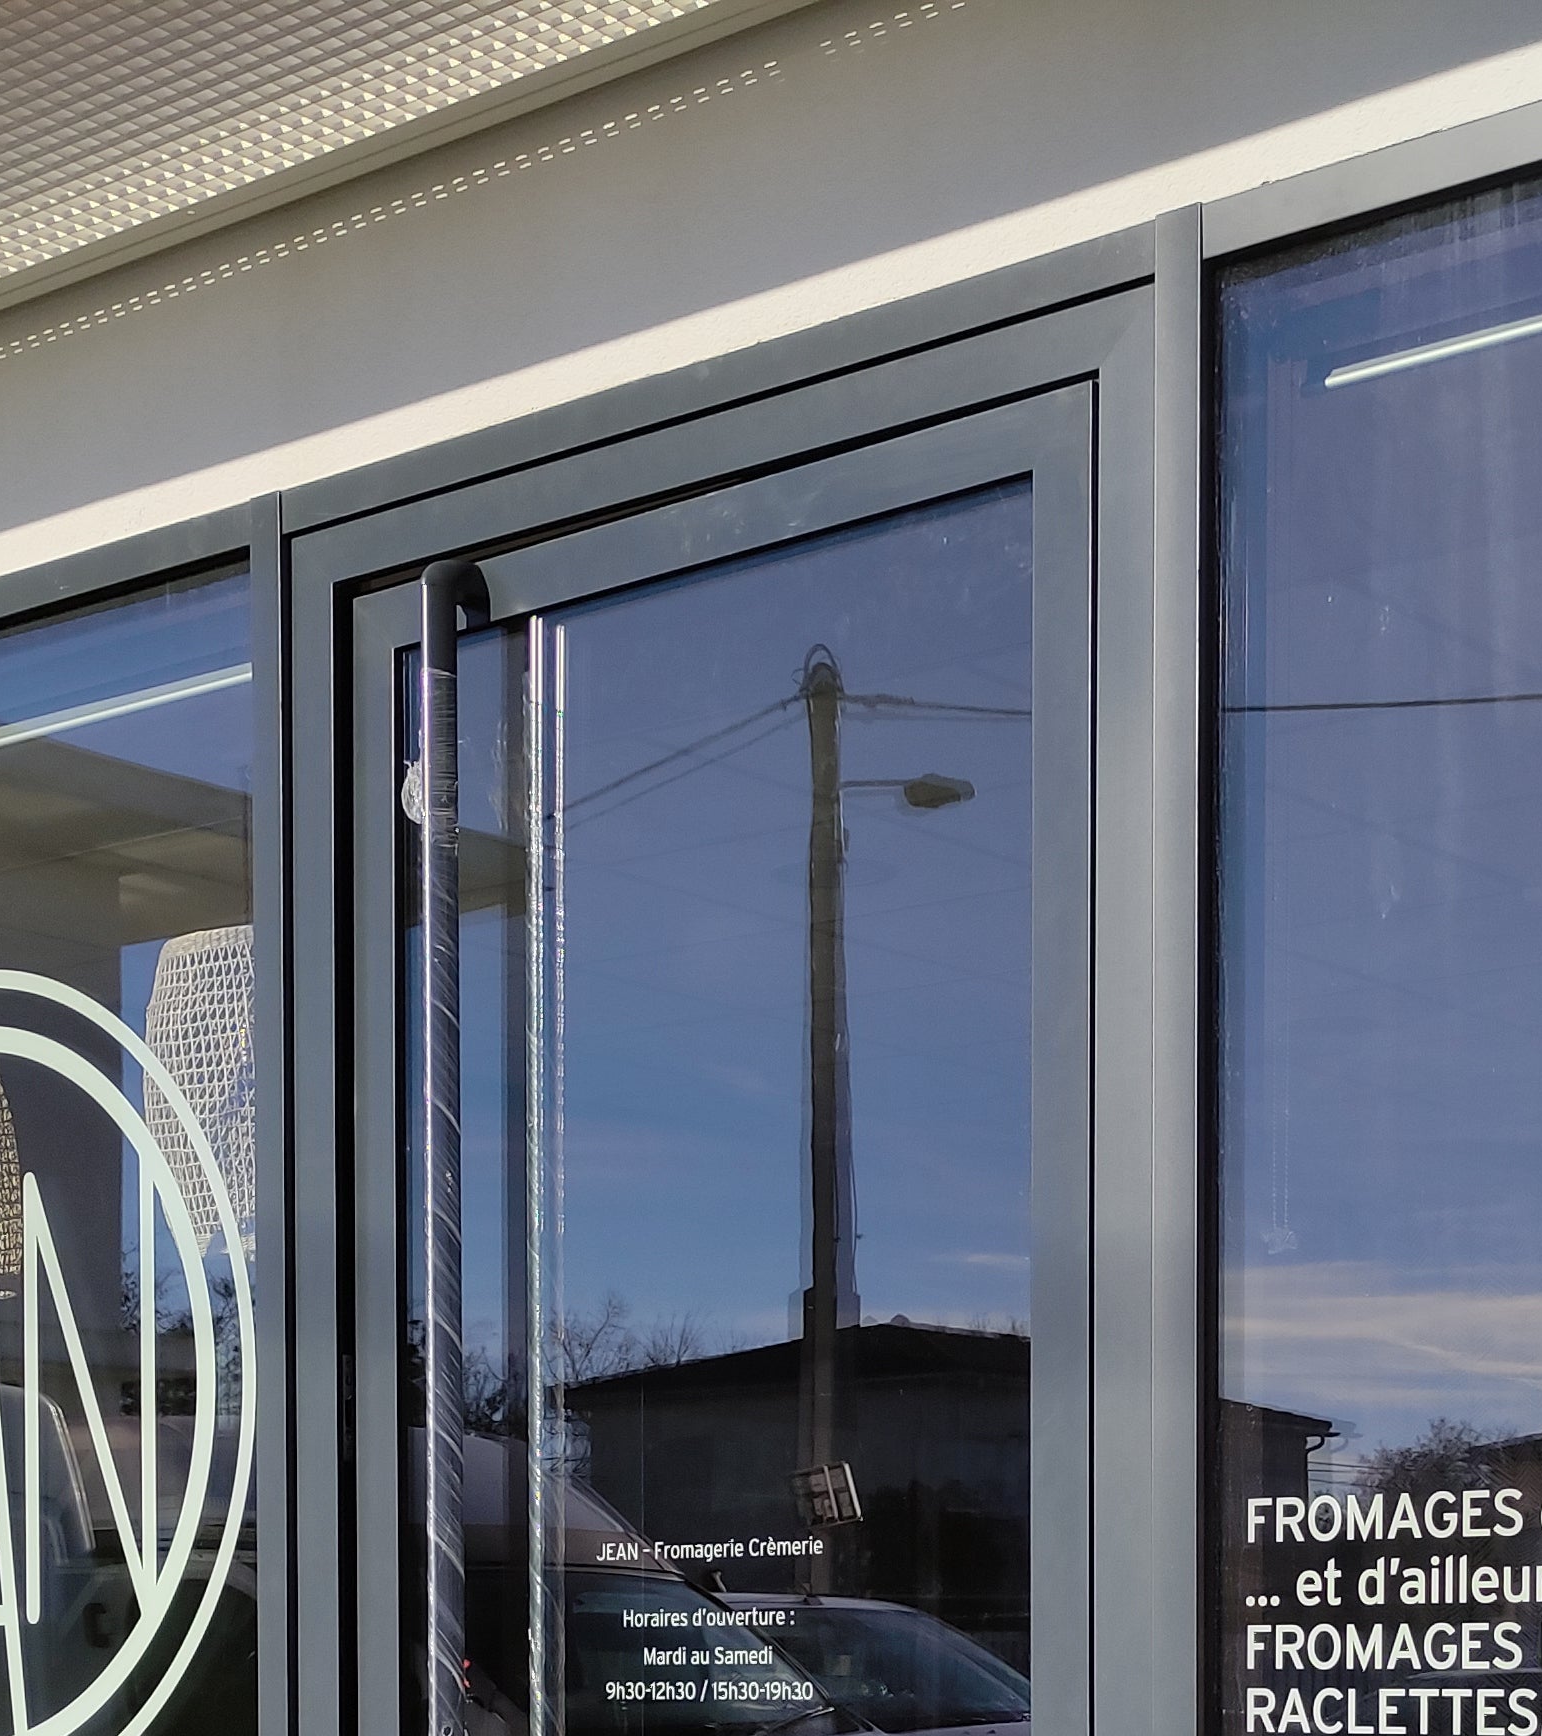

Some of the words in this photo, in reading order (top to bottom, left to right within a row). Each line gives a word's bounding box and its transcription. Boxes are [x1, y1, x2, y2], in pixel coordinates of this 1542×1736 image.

[1244, 1488, 1525, 1545] FROMAGES
[595, 1542, 639, 1562] JEAN
[654, 1538, 744, 1562] Fromagerie
[748, 1535, 824, 1556] Crèmerie
[1295, 1554, 1343, 1607] et
[623, 1608, 688, 1628] Horaires
[643, 1647, 687, 1666] Mardi
[691, 1651, 710, 1665] au
[714, 1646, 773, 1665] Samedi
[1244, 1621, 1525, 1672] FROMAGES
[605, 1680, 697, 1700] 9h30-12h30
[699, 1679, 709, 1702] /
[711, 1680, 814, 1700] 15h30-19h30
